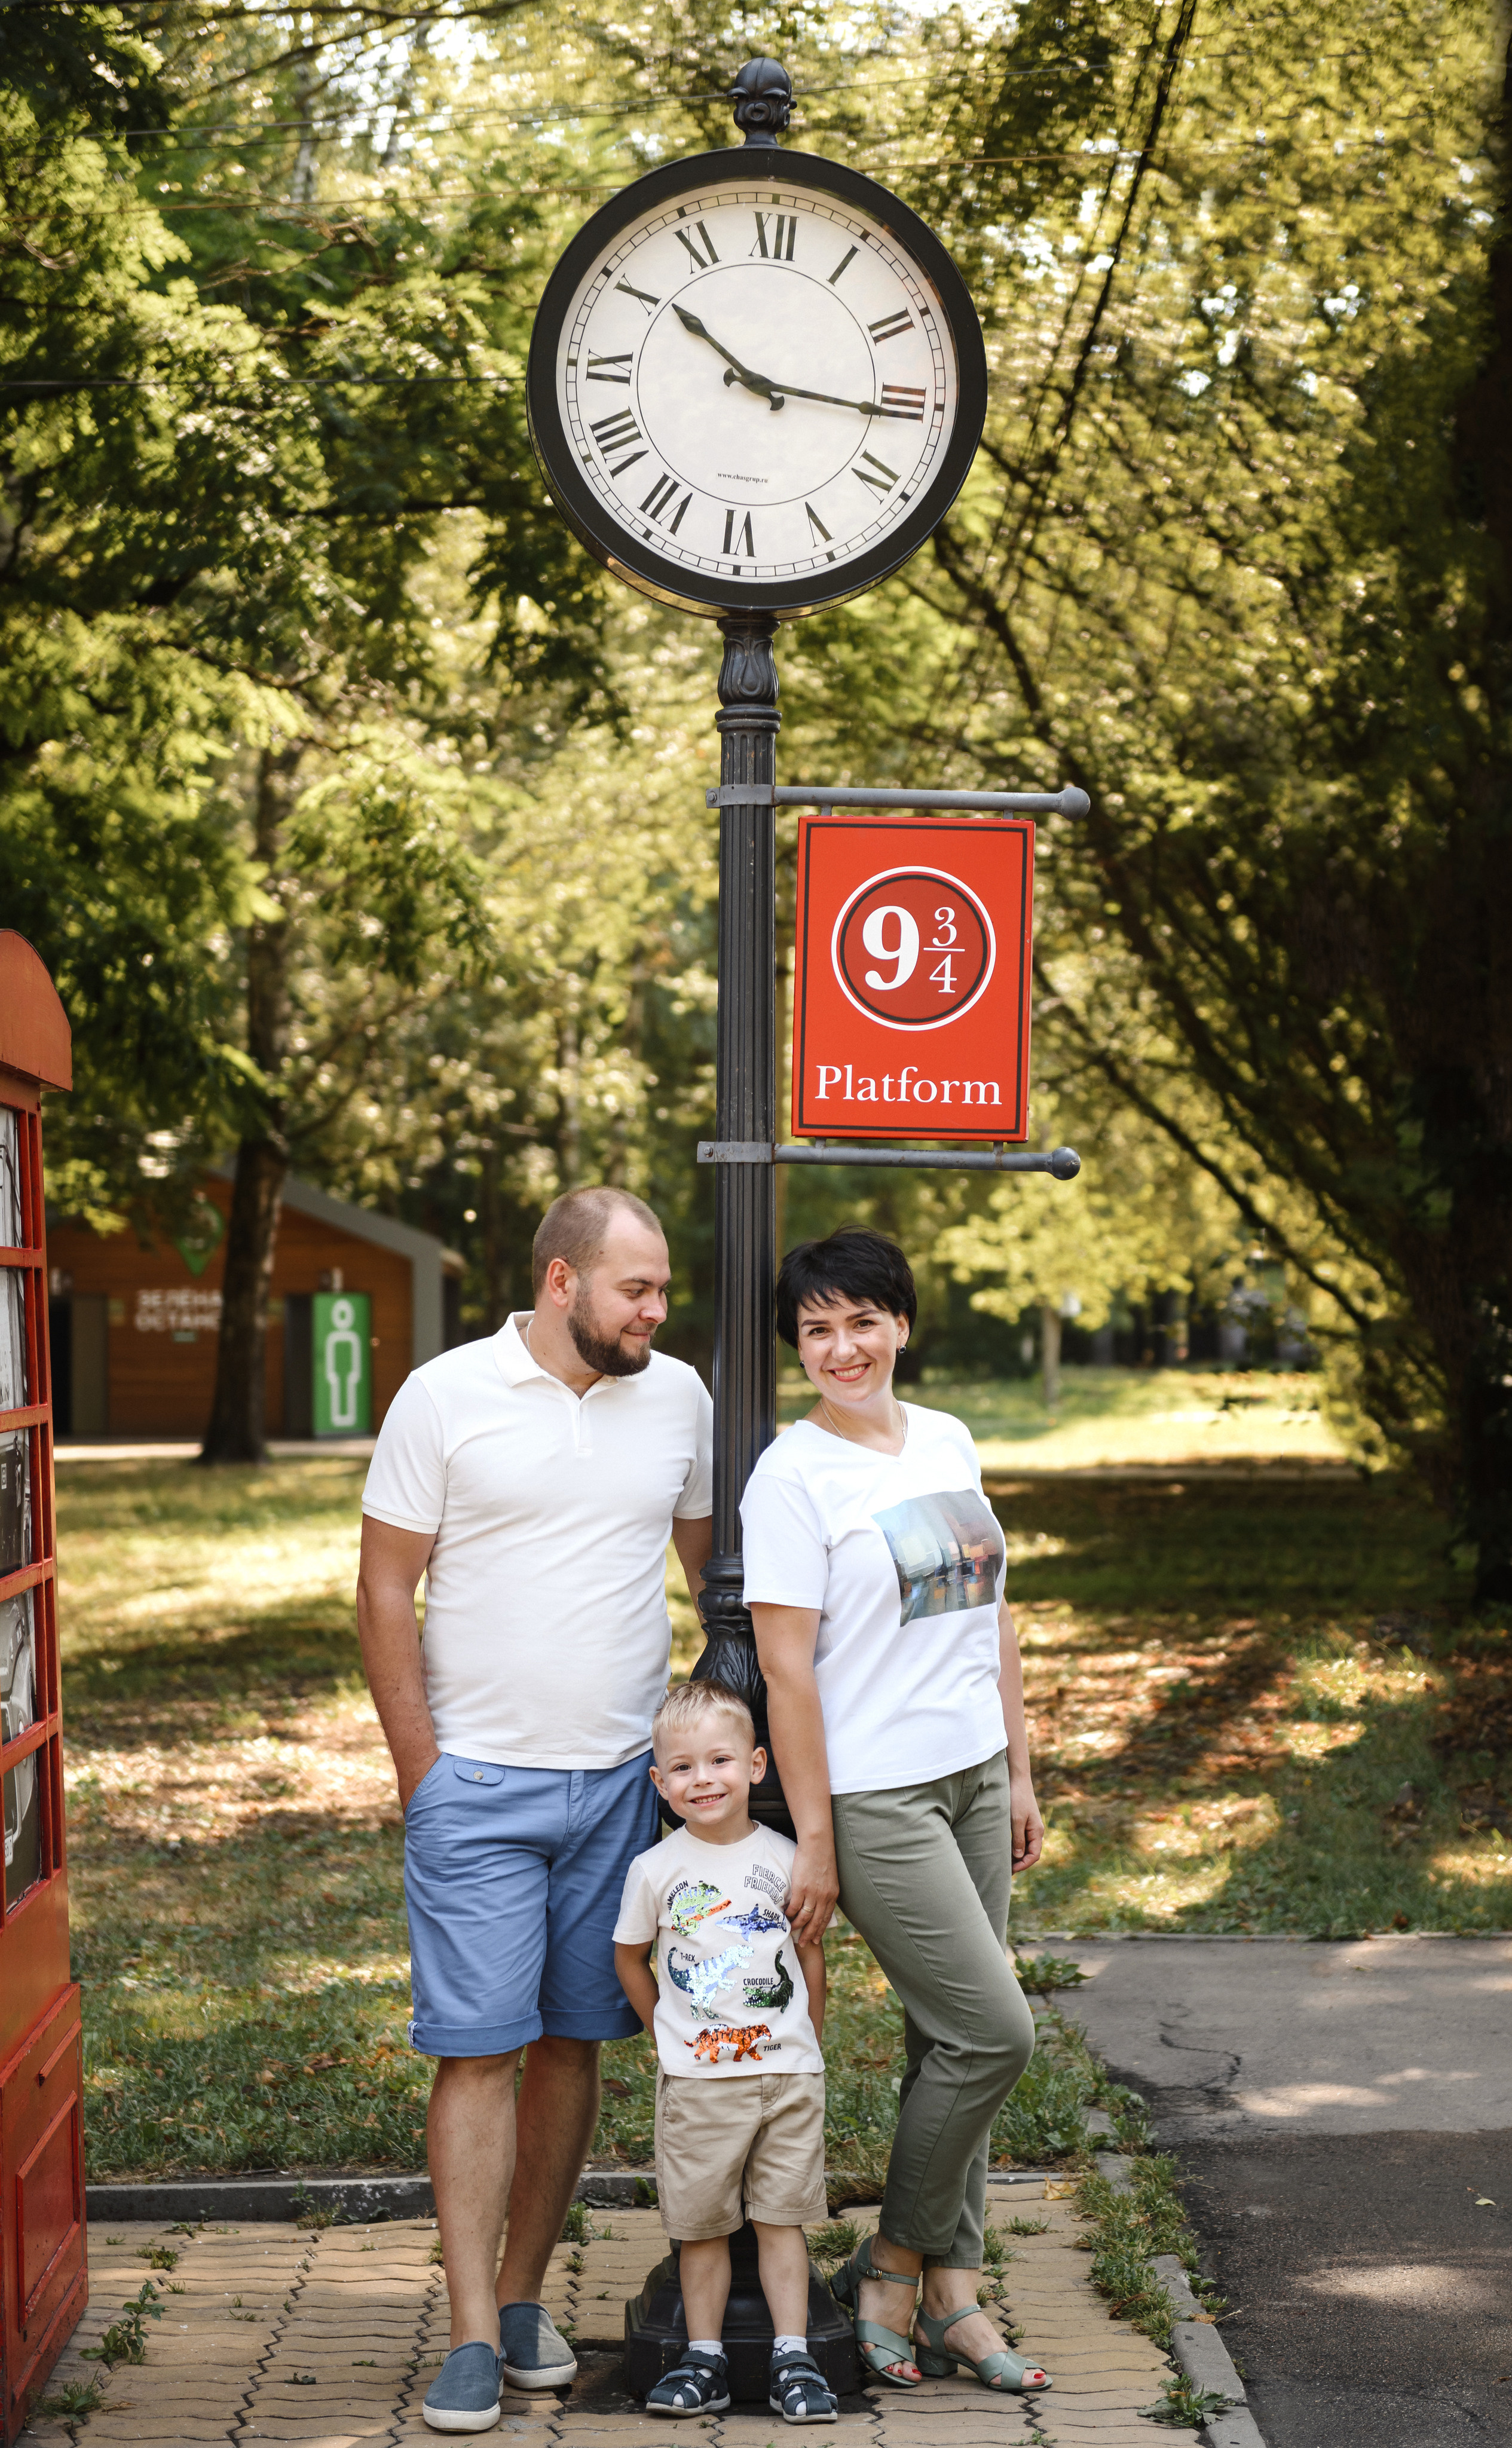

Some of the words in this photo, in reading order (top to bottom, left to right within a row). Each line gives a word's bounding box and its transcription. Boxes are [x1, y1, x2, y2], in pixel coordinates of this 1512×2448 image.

[673, 219, 721, 274] XI
[749, 211, 799, 262] XII
[826, 243, 861, 287] I
[613, 273, 662, 316] X
[867, 307, 916, 345] II
[585, 348, 633, 386] IX
[879, 382, 927, 424] III
[589, 406, 650, 481] VIII
[718, 473, 768, 484] www.chasgrup.ru
[850, 449, 901, 505] IV
[637, 471, 693, 537] VII
[804, 501, 835, 548] V
[720, 508, 757, 558] VI
[815, 1064, 1003, 1105] Platform
[666, 1880, 689, 1915] HAMELEON
[744, 1875, 783, 1905] FRIENDS
[752, 1864, 786, 1892] FIERCE
[762, 1908, 781, 1922] SHARK
[680, 1952, 696, 1962] T-REX
[743, 1977, 774, 1986] CROCODILE
[763, 2043, 782, 2052] TIGER
